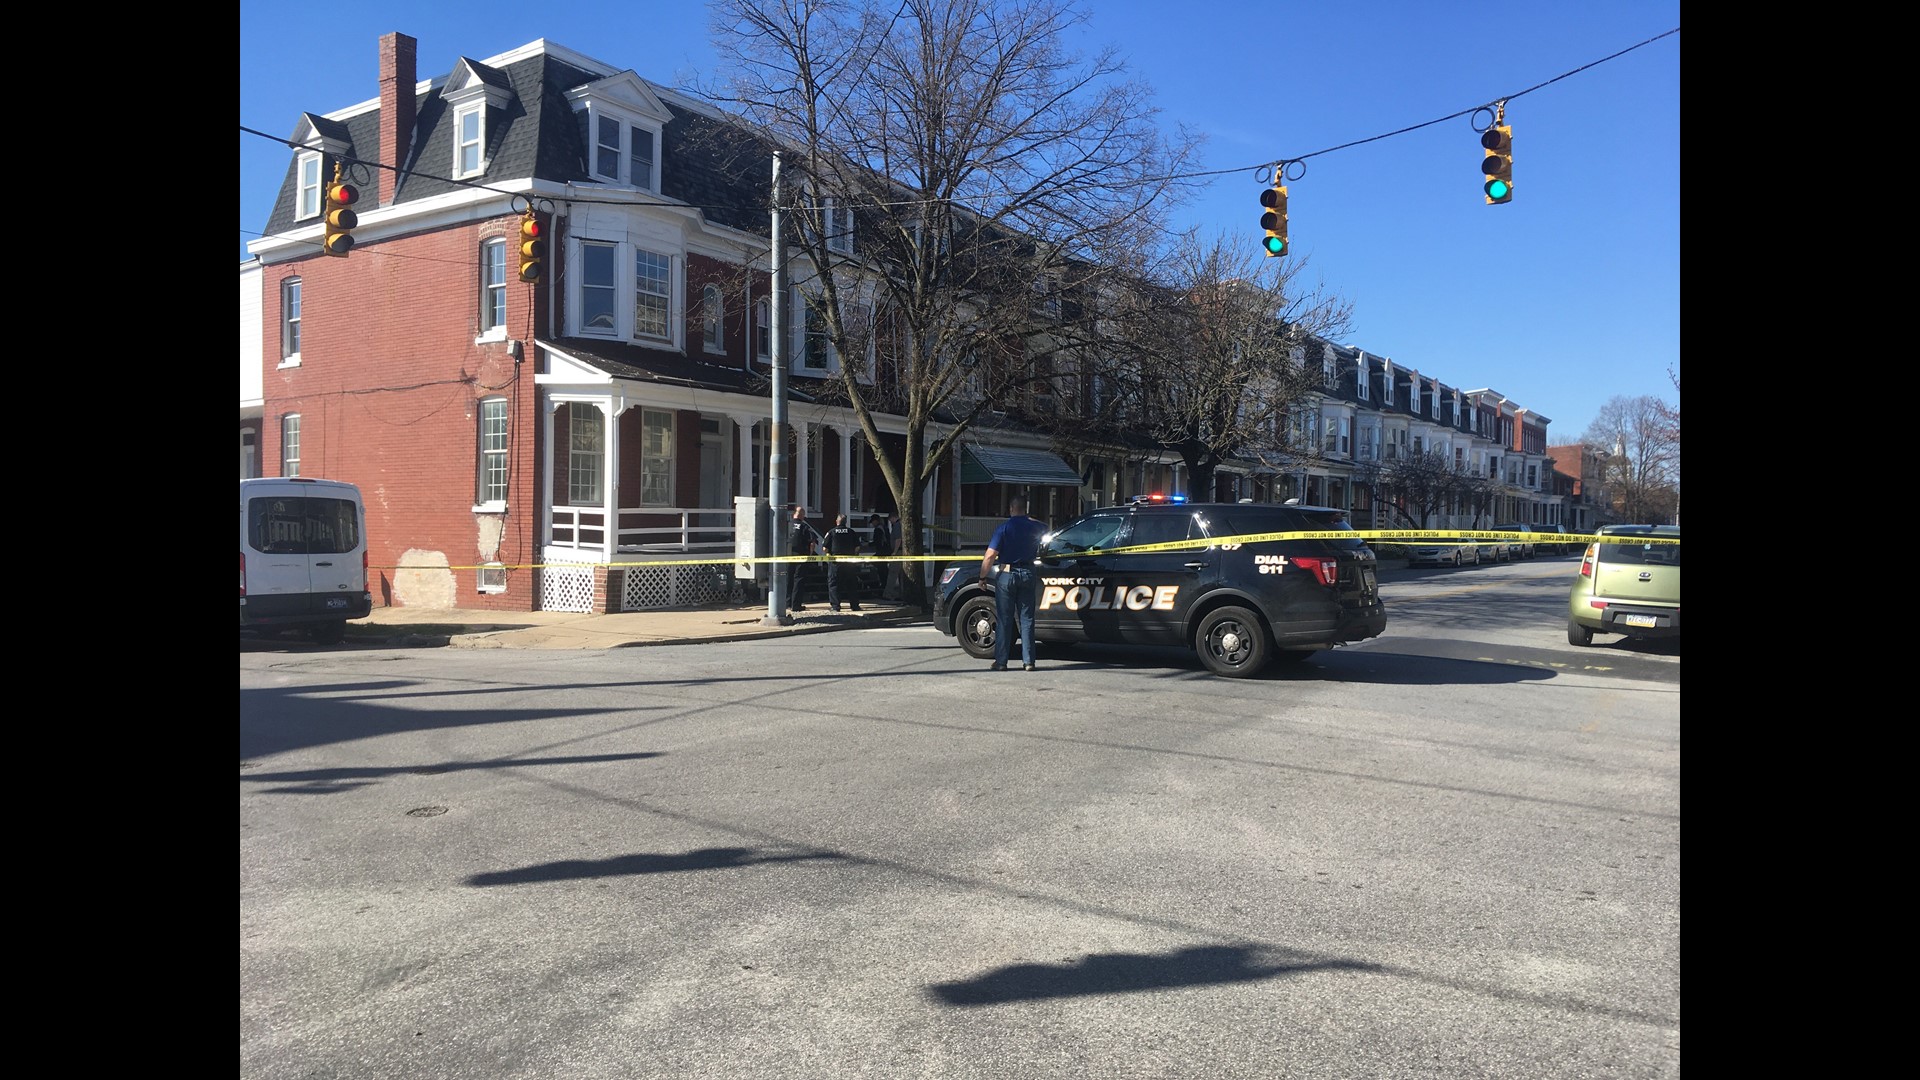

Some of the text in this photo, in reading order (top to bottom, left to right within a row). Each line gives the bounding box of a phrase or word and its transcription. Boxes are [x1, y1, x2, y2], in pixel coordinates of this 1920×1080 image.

[1254, 555, 1288, 565] DIAL
[1258, 564, 1283, 575] 911
[1041, 577, 1104, 586] YORK CITY
[1039, 585, 1180, 611] POLICE
